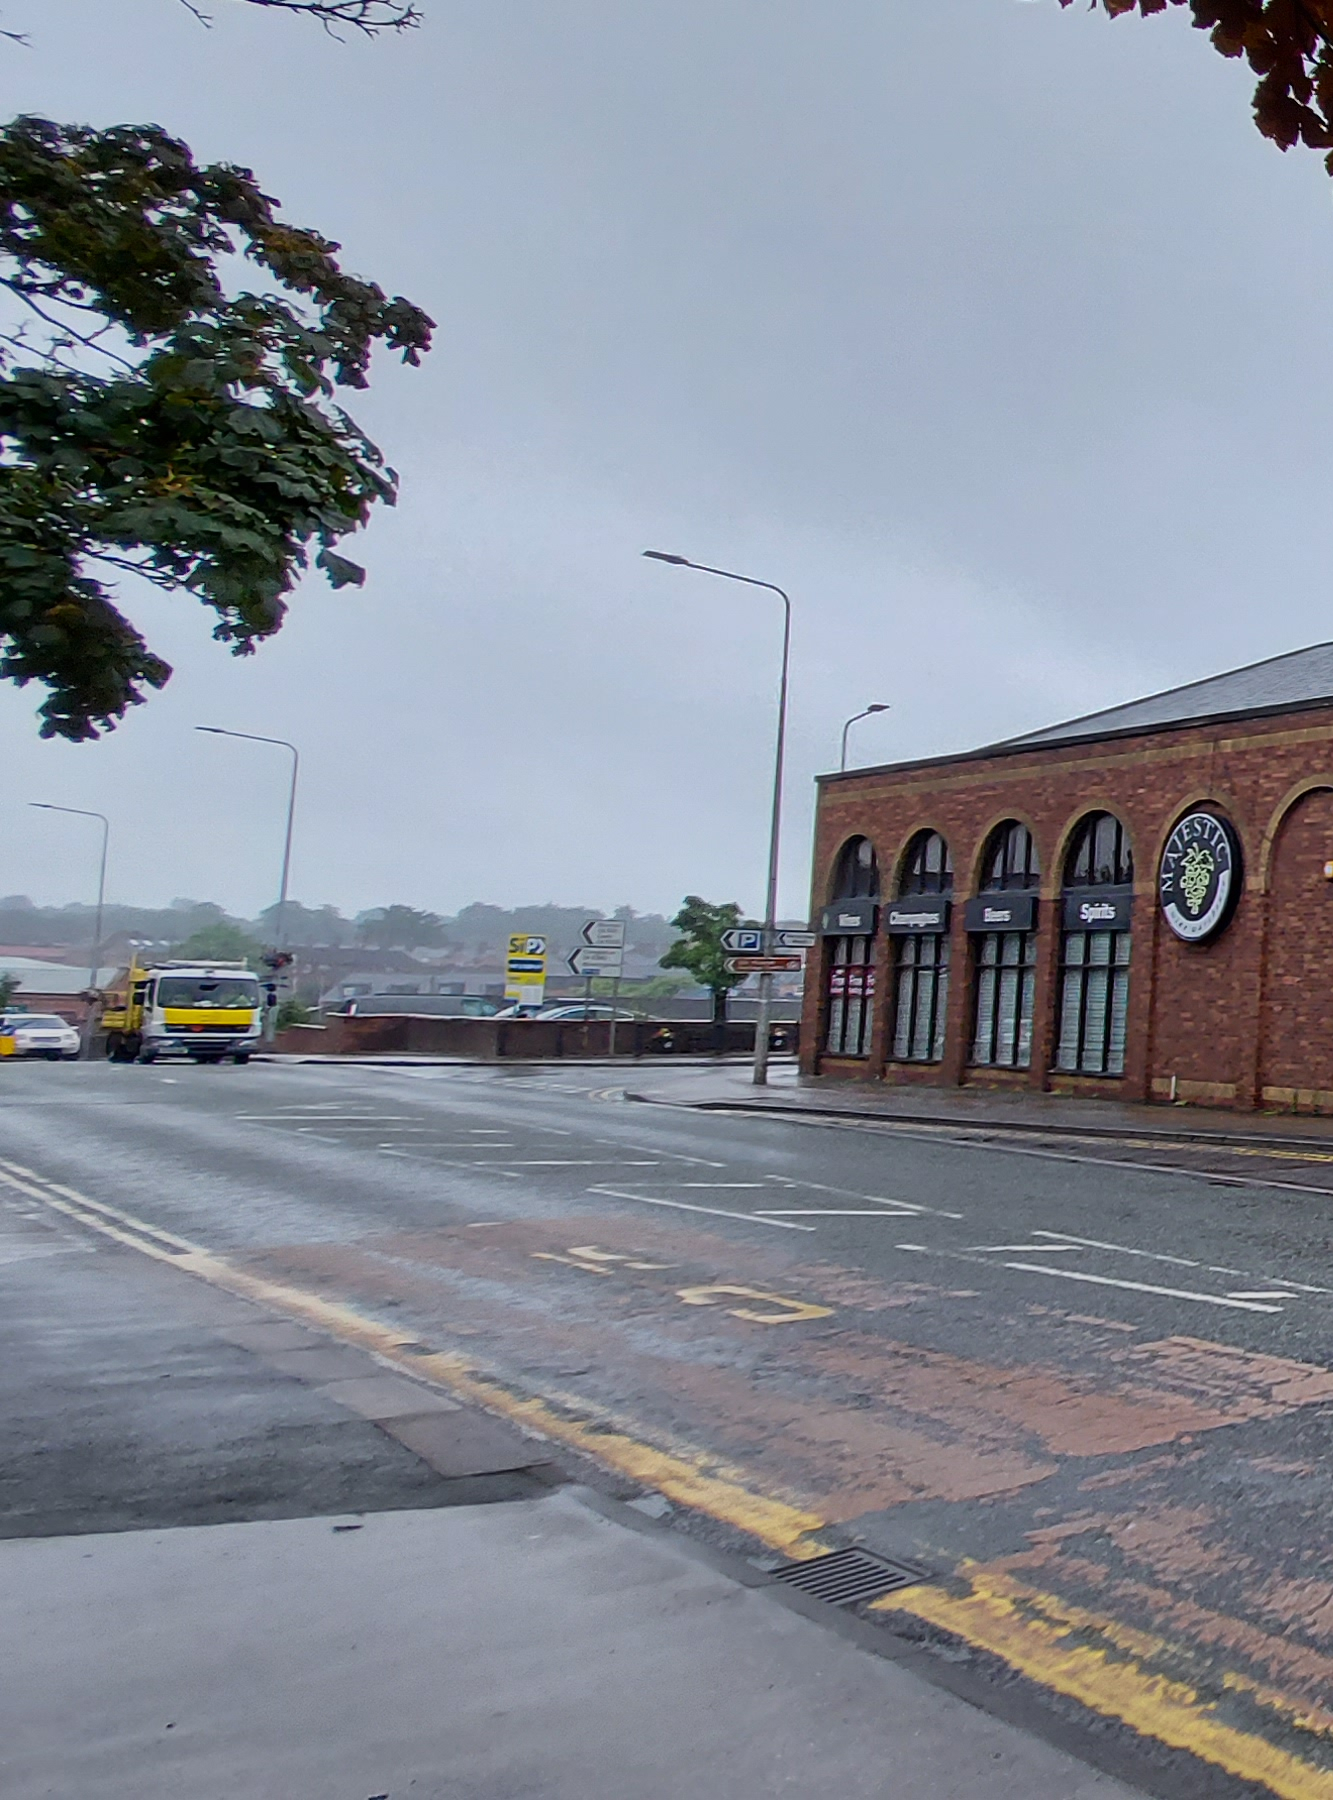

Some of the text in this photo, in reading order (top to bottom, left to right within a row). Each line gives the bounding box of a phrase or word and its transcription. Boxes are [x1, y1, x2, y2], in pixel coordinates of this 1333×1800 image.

[1161, 817, 1227, 892] MAJESTIC
[1080, 903, 1116, 923] Spirits
[741, 934, 756, 948] P
